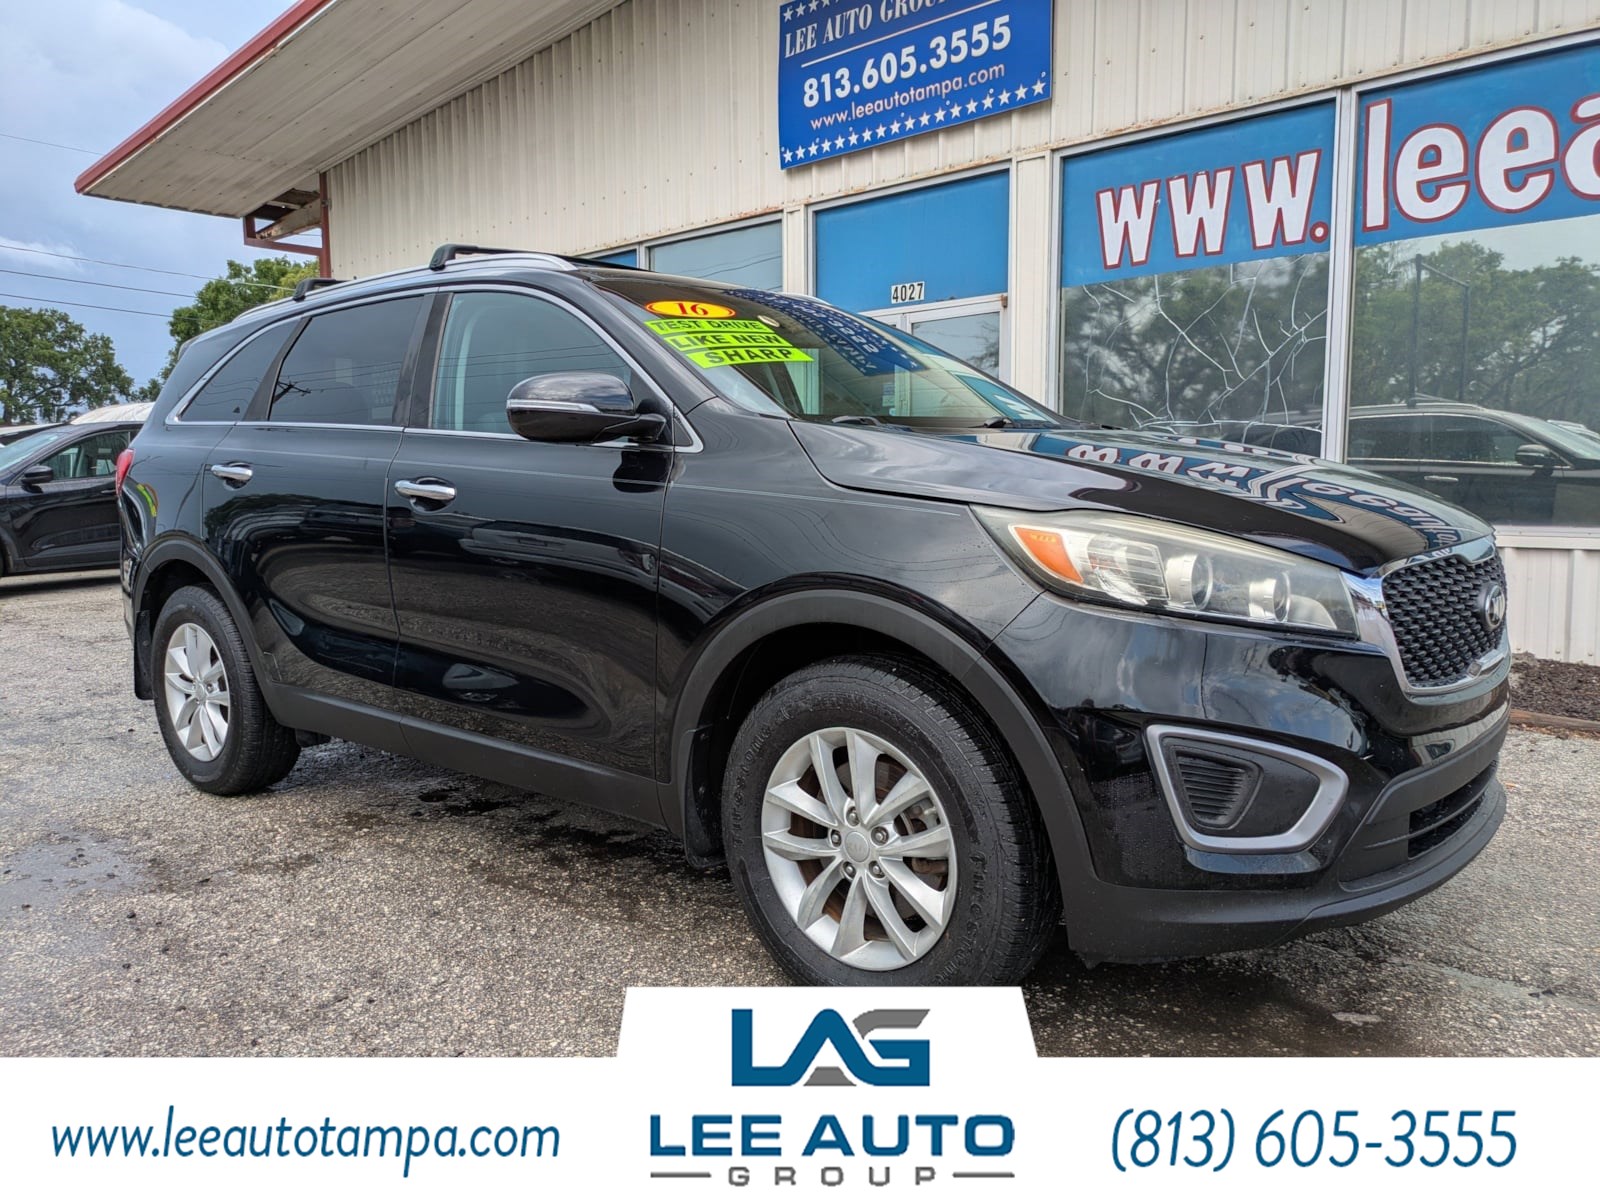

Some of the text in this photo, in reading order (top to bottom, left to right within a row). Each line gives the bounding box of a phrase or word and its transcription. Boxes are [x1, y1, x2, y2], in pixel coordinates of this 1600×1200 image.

[784, 22, 818, 59] LEE
[822, 3, 873, 43] AUTO
[802, 14, 1012, 108] 813.605.3555
[809, 62, 1006, 130] www.leeautotampa.com
[892, 283, 924, 303] 4027
[651, 320, 765, 331] TEST DRIVE
[669, 333, 782, 349] LIKE NEW
[704, 349, 793, 364] SHARP
